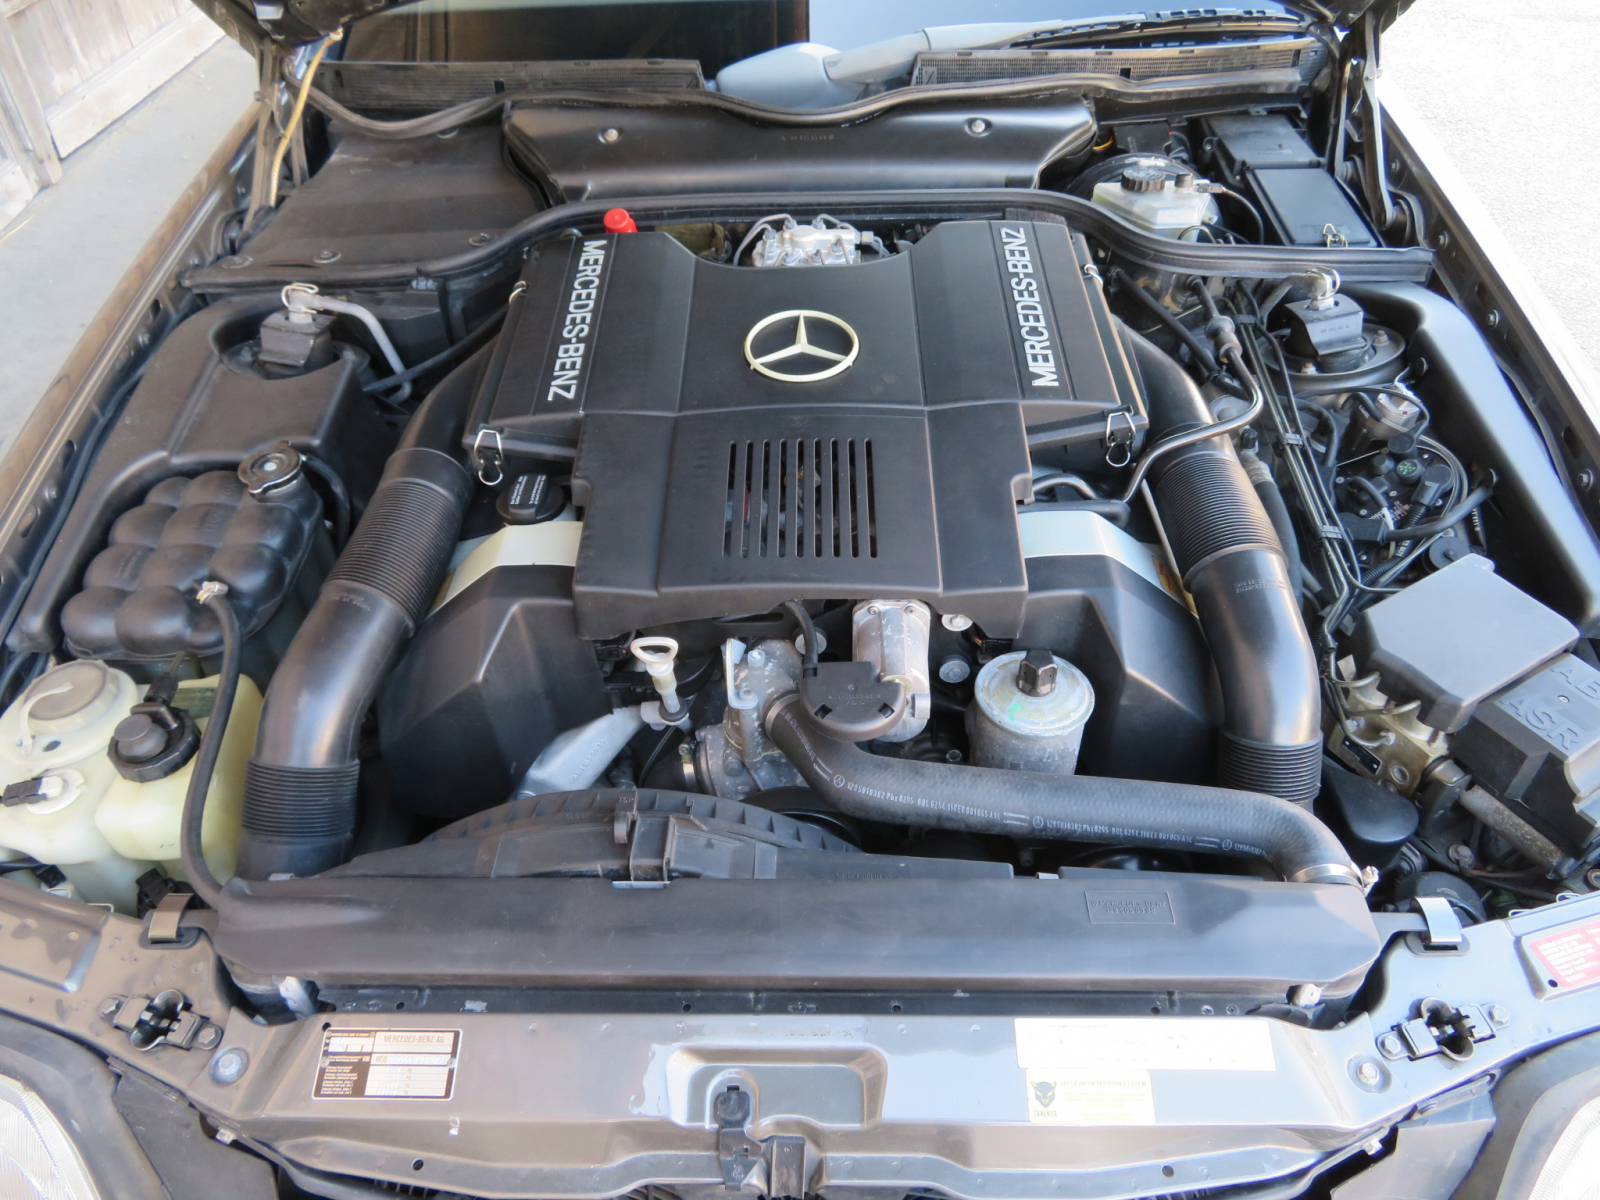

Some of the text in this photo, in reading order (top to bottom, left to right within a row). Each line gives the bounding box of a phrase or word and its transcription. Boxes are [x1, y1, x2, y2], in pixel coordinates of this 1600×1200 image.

[547, 239, 608, 402] MERCEDES-BENZ
[999, 226, 1060, 387] MERCEDES-BENZ
[1497, 690, 1584, 751] ASR
[383, 1035, 445, 1043] MERCEDES-BENZ AG
[1033, 1110, 1058, 1118] TRACKER
